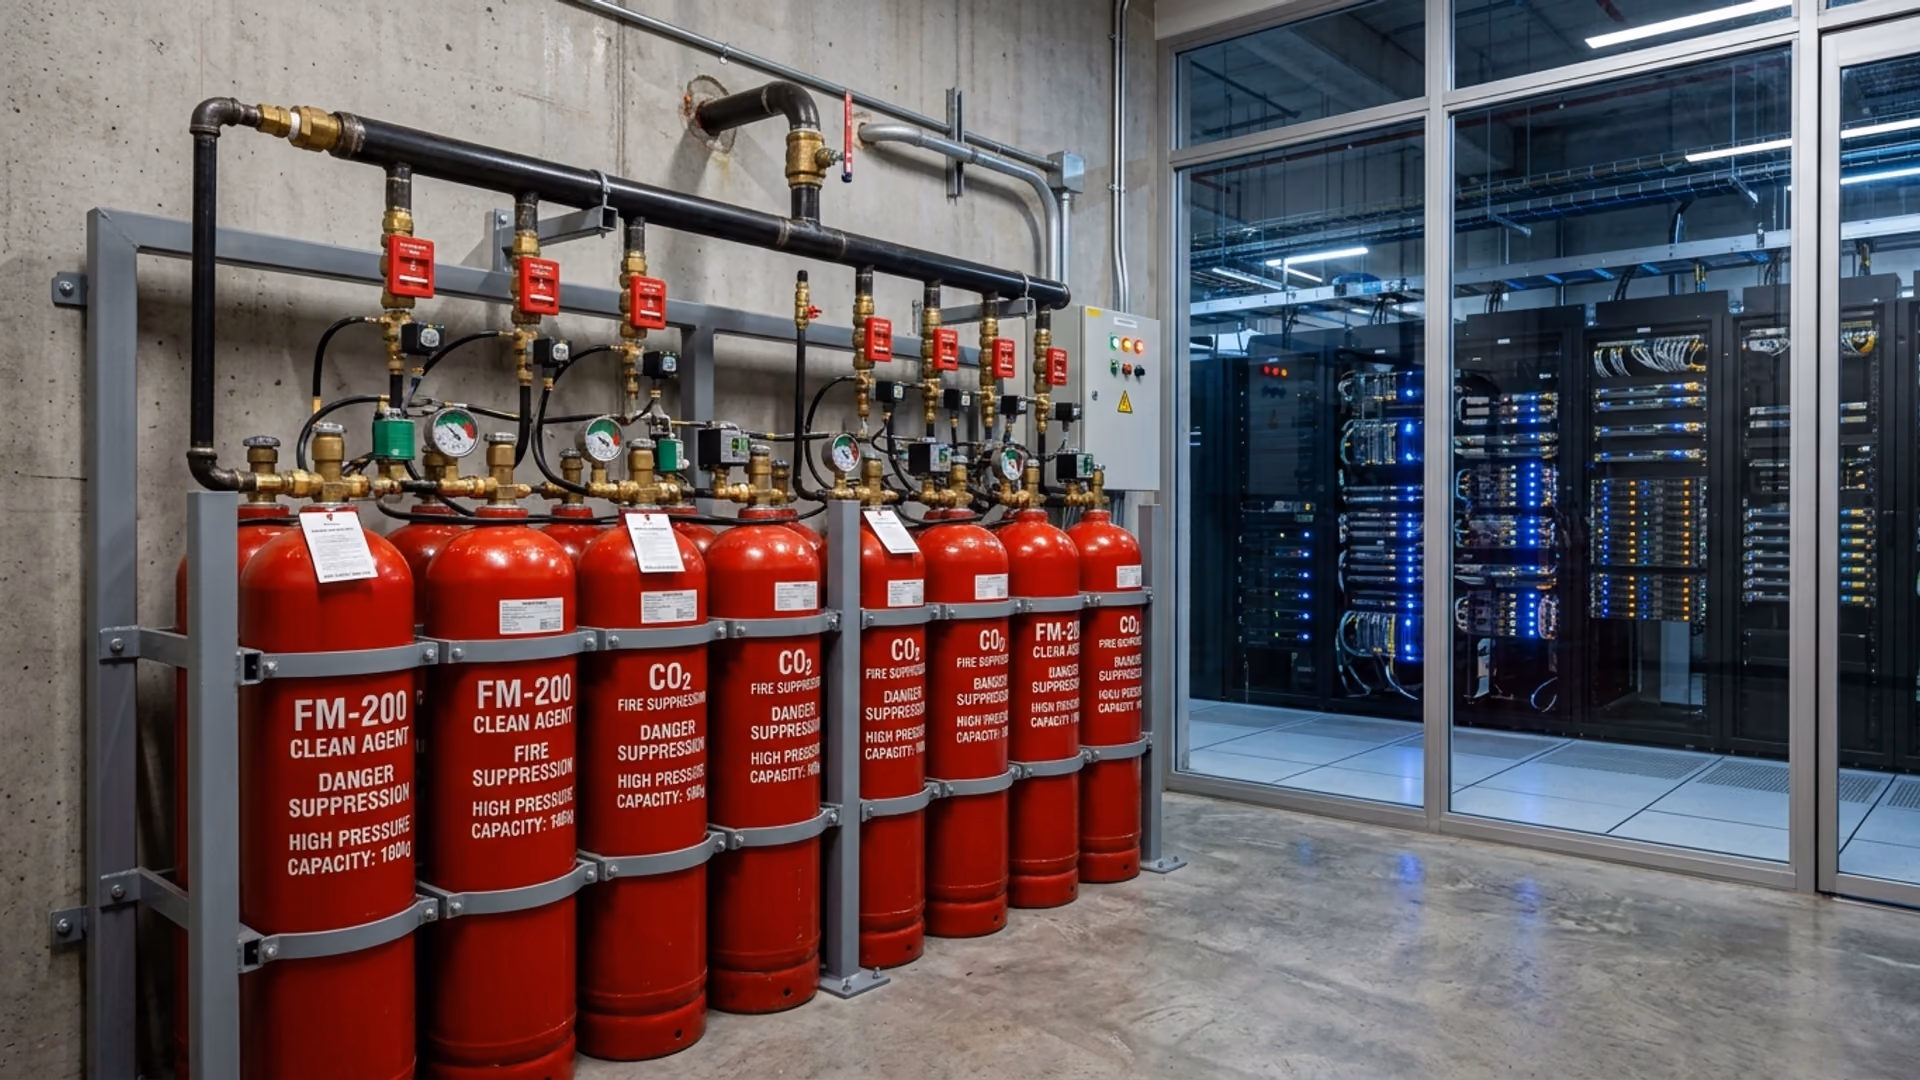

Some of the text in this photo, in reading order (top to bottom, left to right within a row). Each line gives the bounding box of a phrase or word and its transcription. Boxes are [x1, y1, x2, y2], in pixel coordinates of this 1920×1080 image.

[957, 657, 977, 668] FIRE
[866, 668, 887, 679] FIRE
[477, 673, 571, 709] FM-200
[751, 683, 774, 695] FIRE
[294, 690, 407, 731] FM-200
[617, 698, 643, 711] FIRE
[771, 702, 815, 721] DANGER
[473, 706, 573, 733] CLEAN AGENT
[640, 719, 696, 740] DANGER
[290, 726, 409, 759] CLEAN AGENT
[866, 731, 893, 743] HIGH
[514, 742, 550, 762] FIRE
[751, 751, 780, 765] HIGH
[318, 764, 394, 792] DANGER
[473, 757, 573, 787] SUPPRESSION
[617, 773, 651, 788] HIGH
[289, 782, 410, 818] SUPPRESSION
[472, 800, 510, 817] HIGH
[617, 789, 683, 809] CAPACITY:
[289, 815, 411, 851] HIGH PRESSURE
[471, 816, 546, 839] CAPACITY:
[288, 850, 376, 876] CAPACITY:
